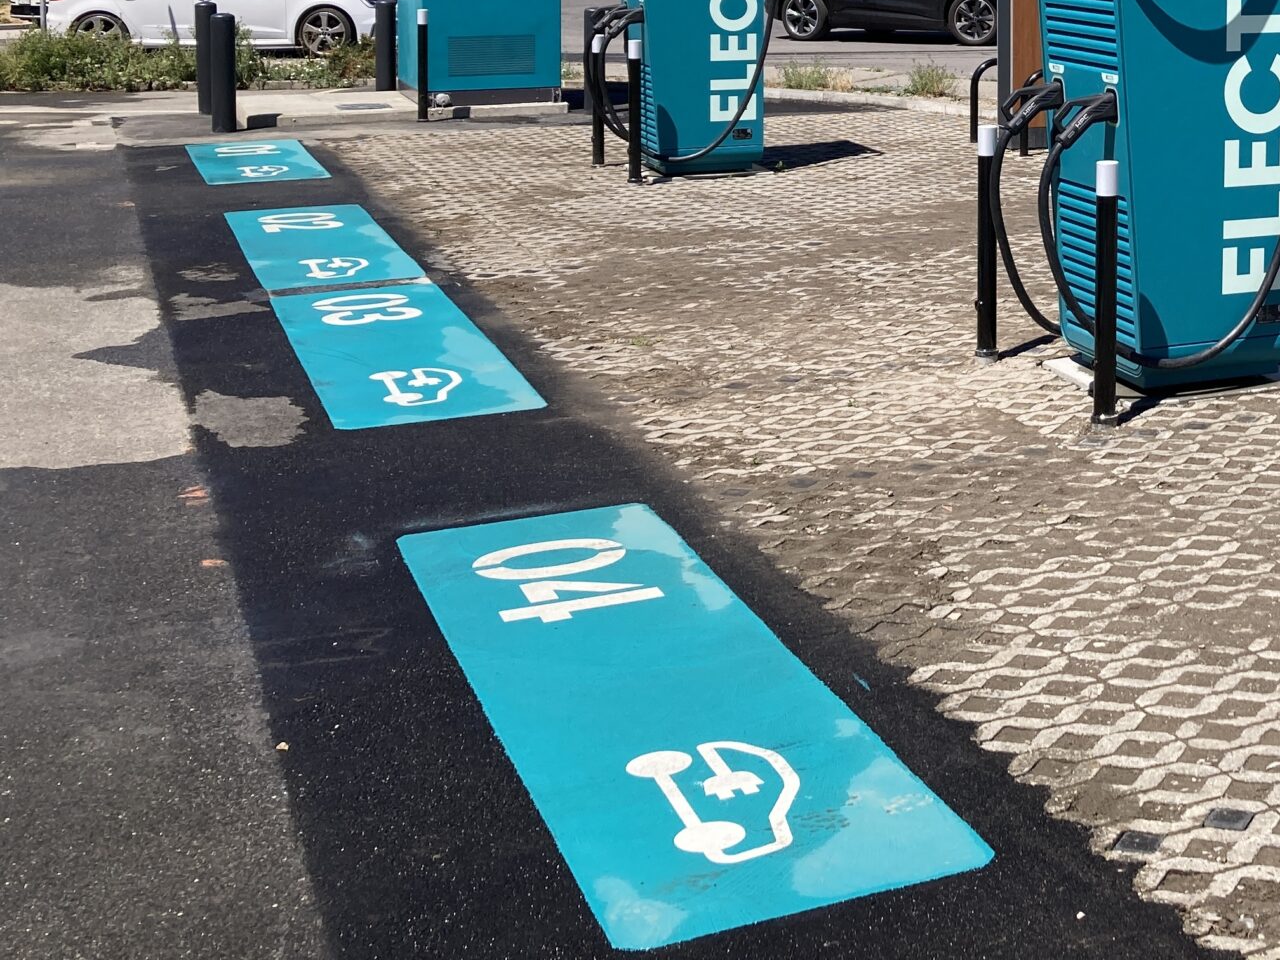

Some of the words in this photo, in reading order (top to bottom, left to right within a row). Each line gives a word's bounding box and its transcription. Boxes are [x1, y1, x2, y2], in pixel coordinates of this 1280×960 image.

[1075, 113, 1090, 128] HPC
[214, 144, 281, 157] 01
[257, 212, 344, 233] 02
[311, 293, 423, 326] 03
[472, 538, 666, 624] 04
